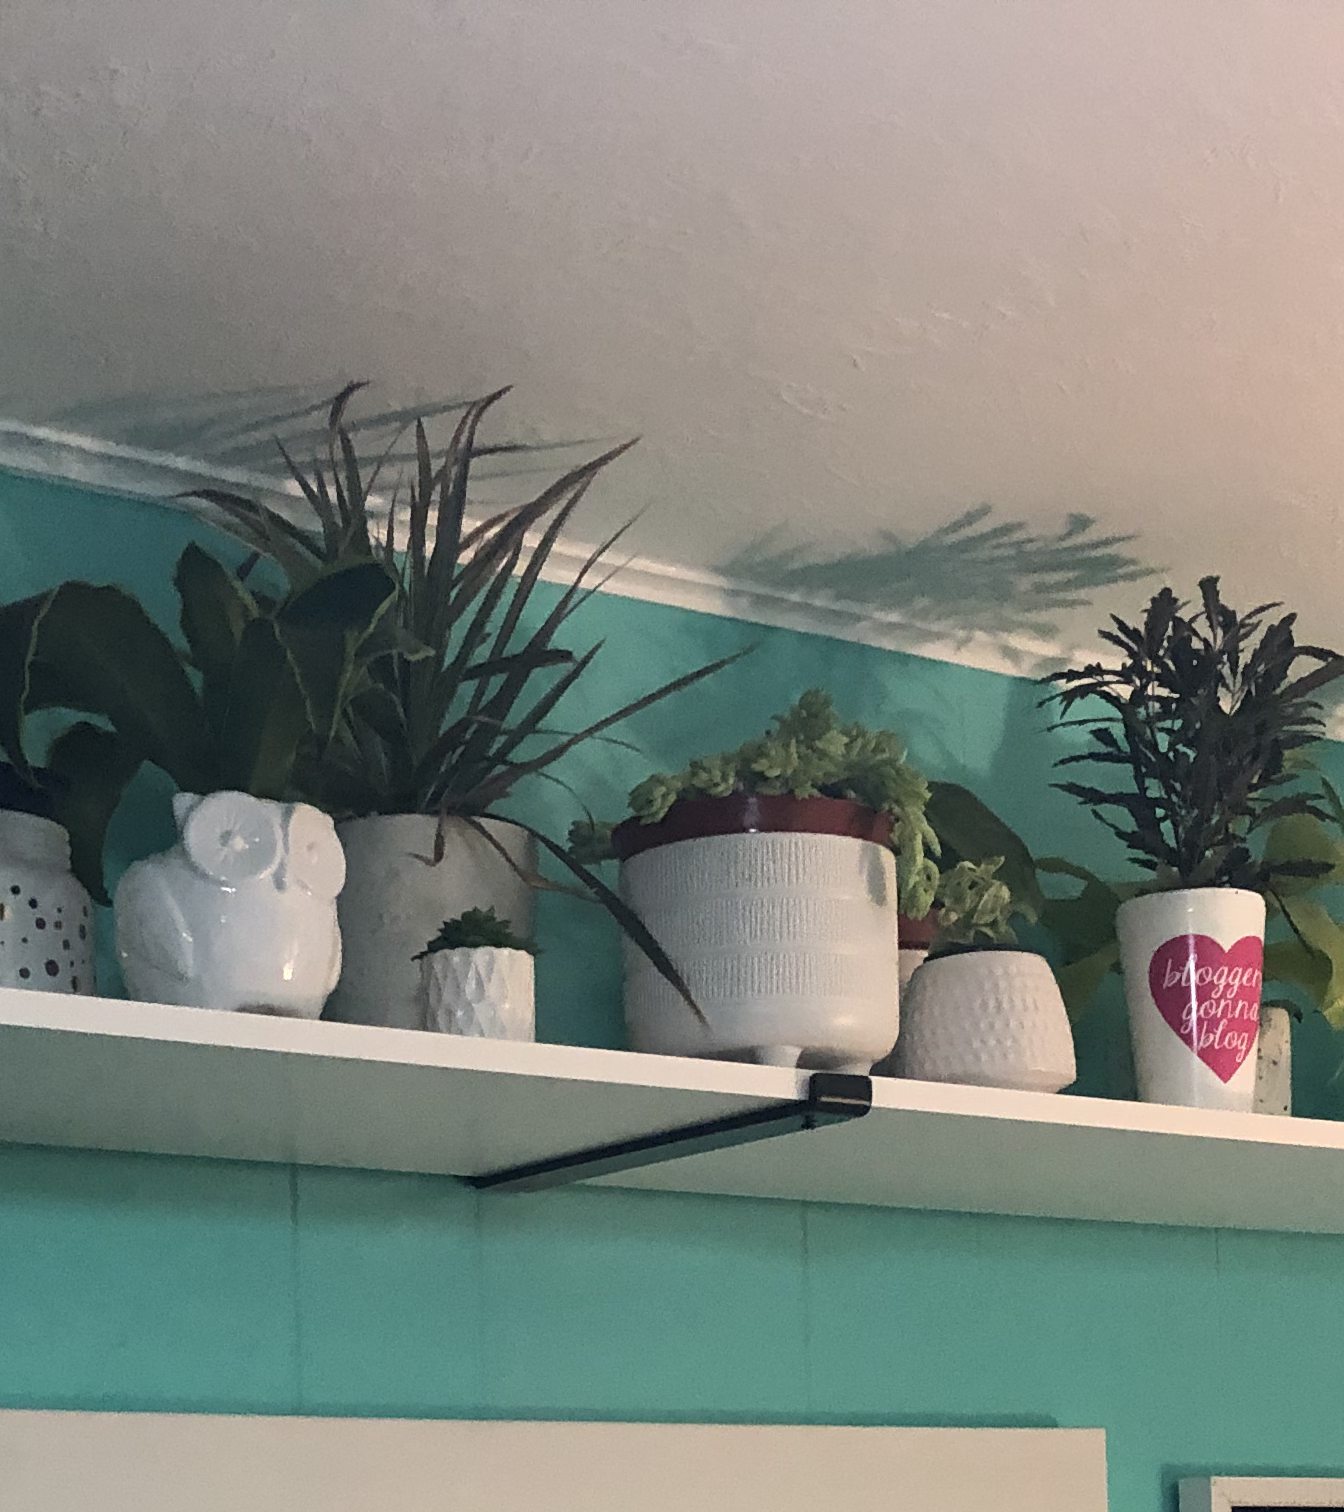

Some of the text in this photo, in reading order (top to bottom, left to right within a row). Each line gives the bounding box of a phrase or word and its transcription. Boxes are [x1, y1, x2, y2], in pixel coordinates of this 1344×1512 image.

[1163, 954, 1262, 998] blogger
[1180, 998, 1260, 1034] gonna
[1198, 1020, 1249, 1063] blog
